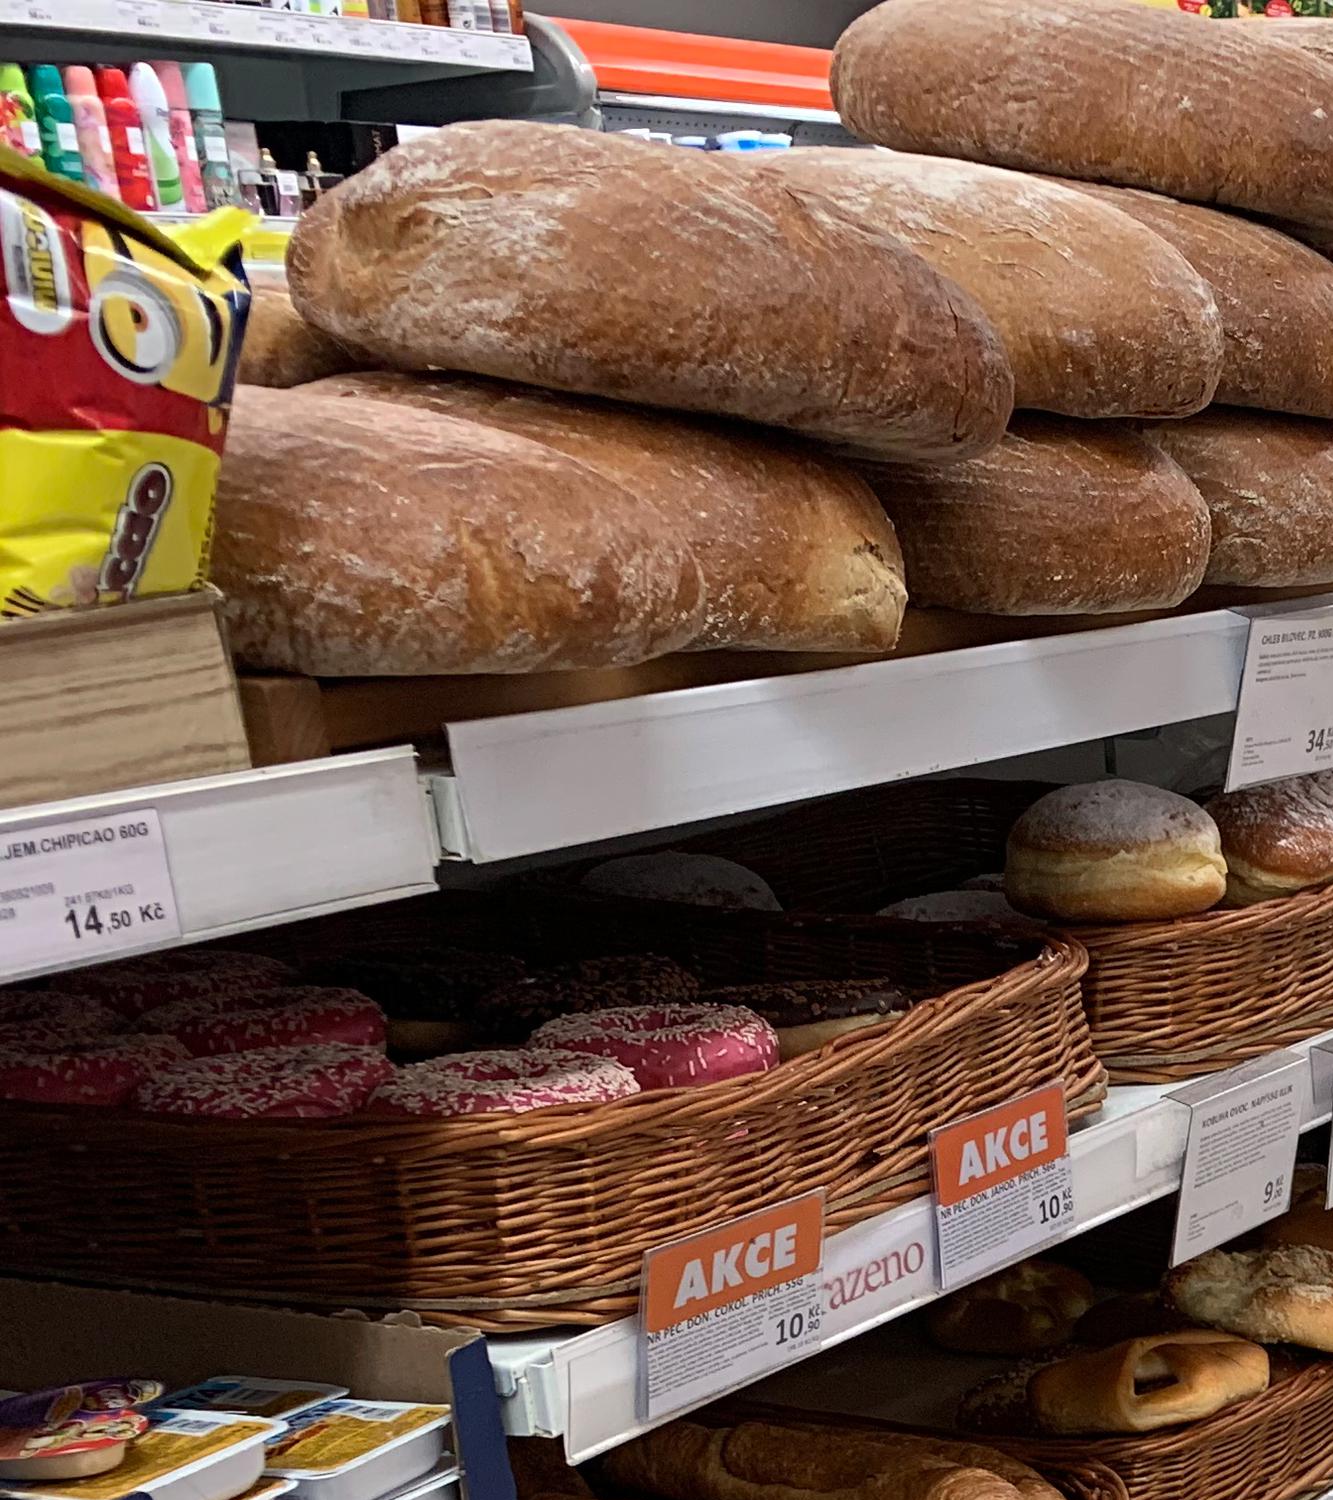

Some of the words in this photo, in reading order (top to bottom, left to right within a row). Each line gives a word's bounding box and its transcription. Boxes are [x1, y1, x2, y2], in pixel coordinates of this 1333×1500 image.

[1306, 728, 1325, 753] 34
[119, 822, 149, 839] 60G
[64, 904, 132, 939] 14,50
[138, 902, 165, 923] Kč
[958, 1110, 1050, 1188] AKCE
[1038, 1194, 1061, 1225] 10
[672, 1222, 798, 1310] AKCE
[824, 1241, 926, 1310] azeno
[775, 1312, 804, 1347] 10
